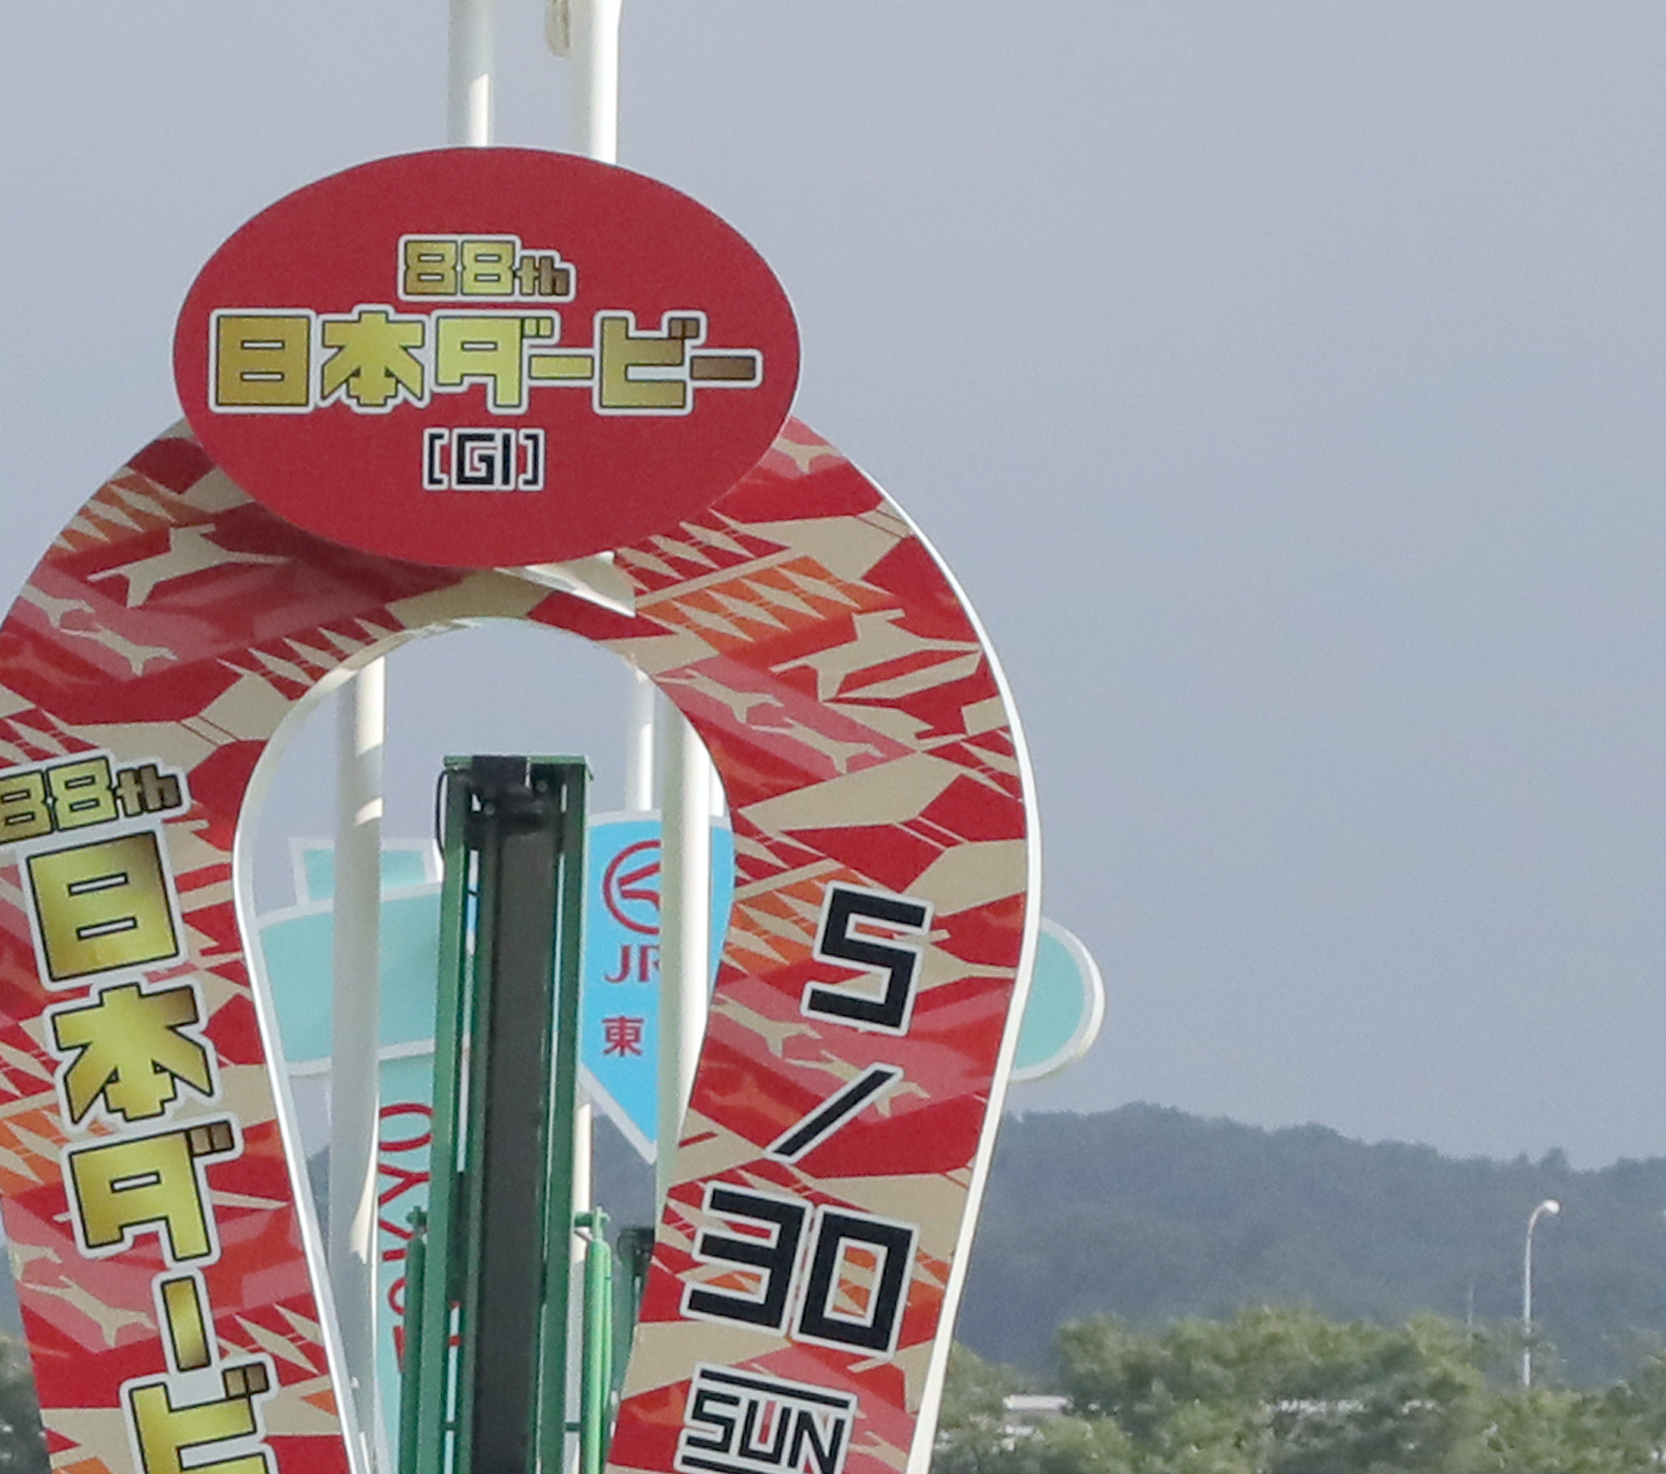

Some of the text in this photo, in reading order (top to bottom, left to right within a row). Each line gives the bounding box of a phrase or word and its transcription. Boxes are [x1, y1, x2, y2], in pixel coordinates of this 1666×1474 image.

[402, 238, 571, 297] 88th
[213, 309, 758, 408] 日本ダービー
